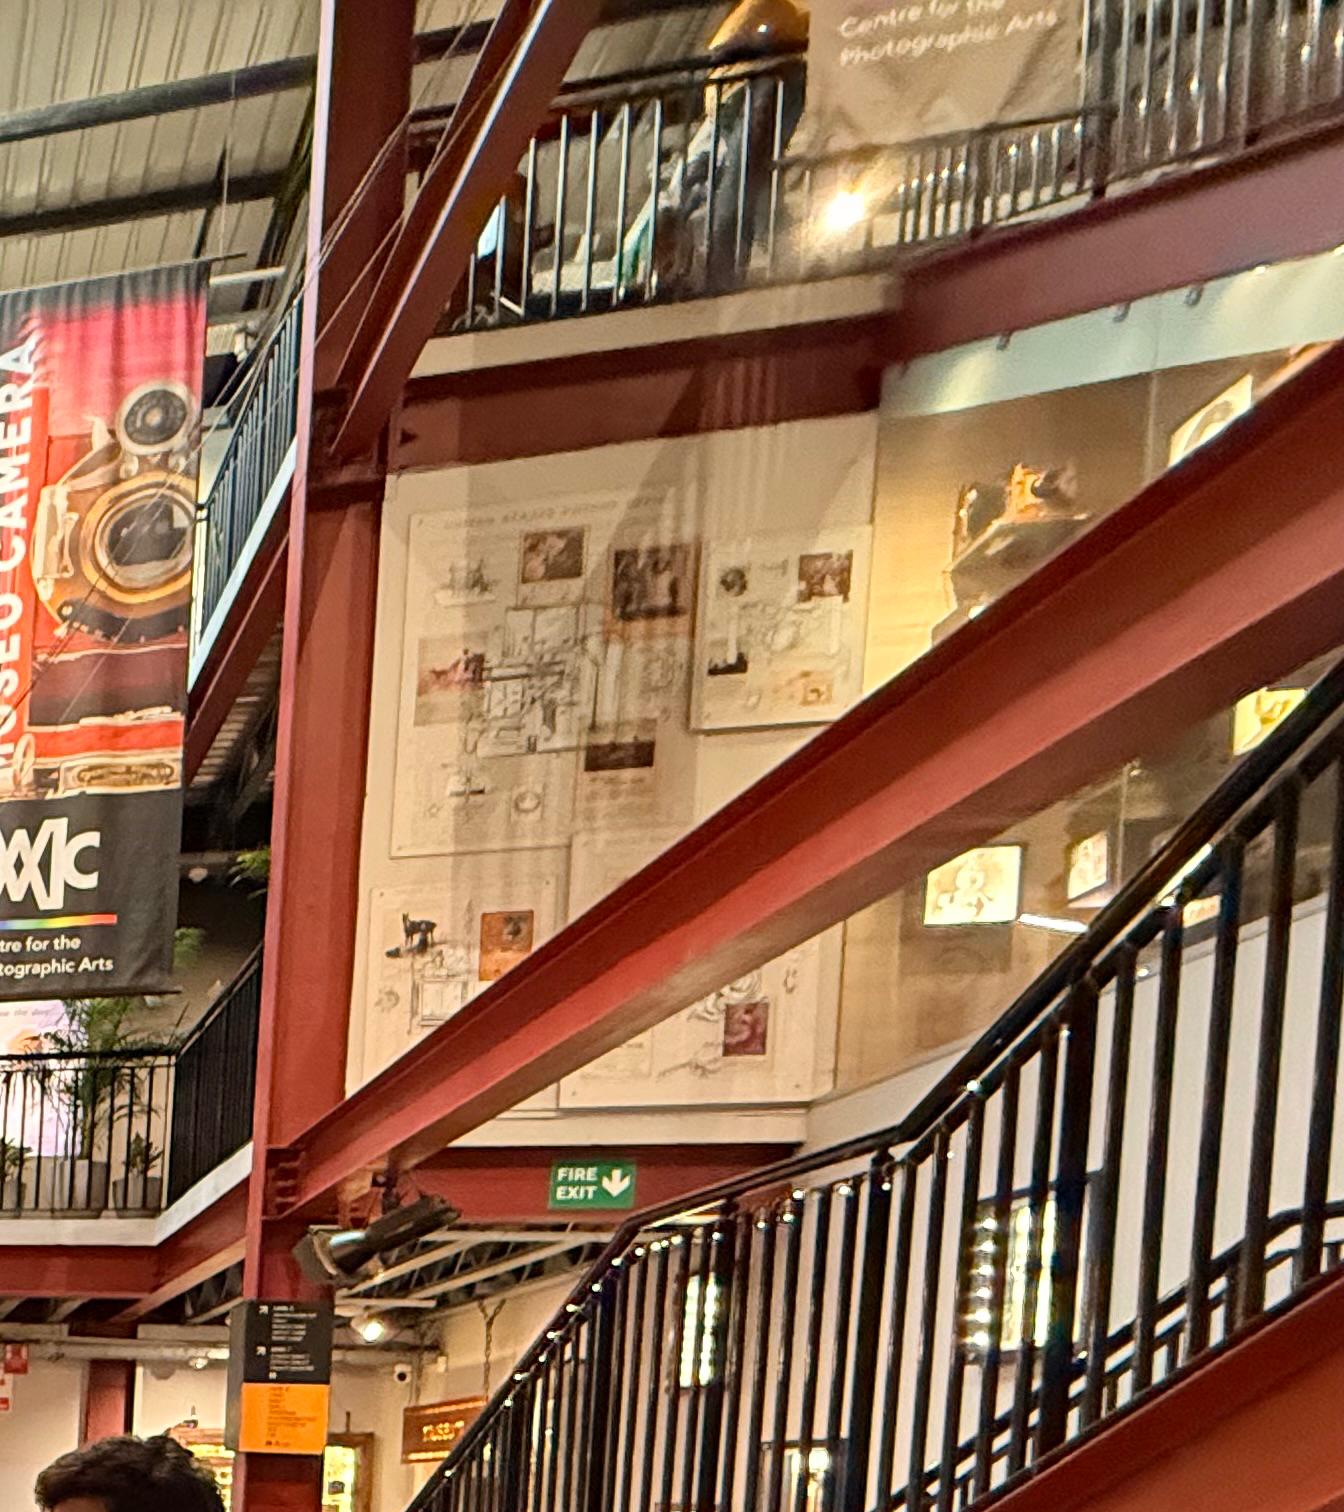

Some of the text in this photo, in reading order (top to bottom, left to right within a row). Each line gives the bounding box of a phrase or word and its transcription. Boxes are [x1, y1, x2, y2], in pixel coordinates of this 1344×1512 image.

[839, 5, 923, 38] Centre
[839, 8, 1058, 66] Photographic Arts
[25, 935, 50, 953] for
[53, 934, 81, 951] the
[78, 956, 114, 972] Arts
[557, 1167, 598, 1182] FIRE
[556, 1185, 598, 1200] EXIT
